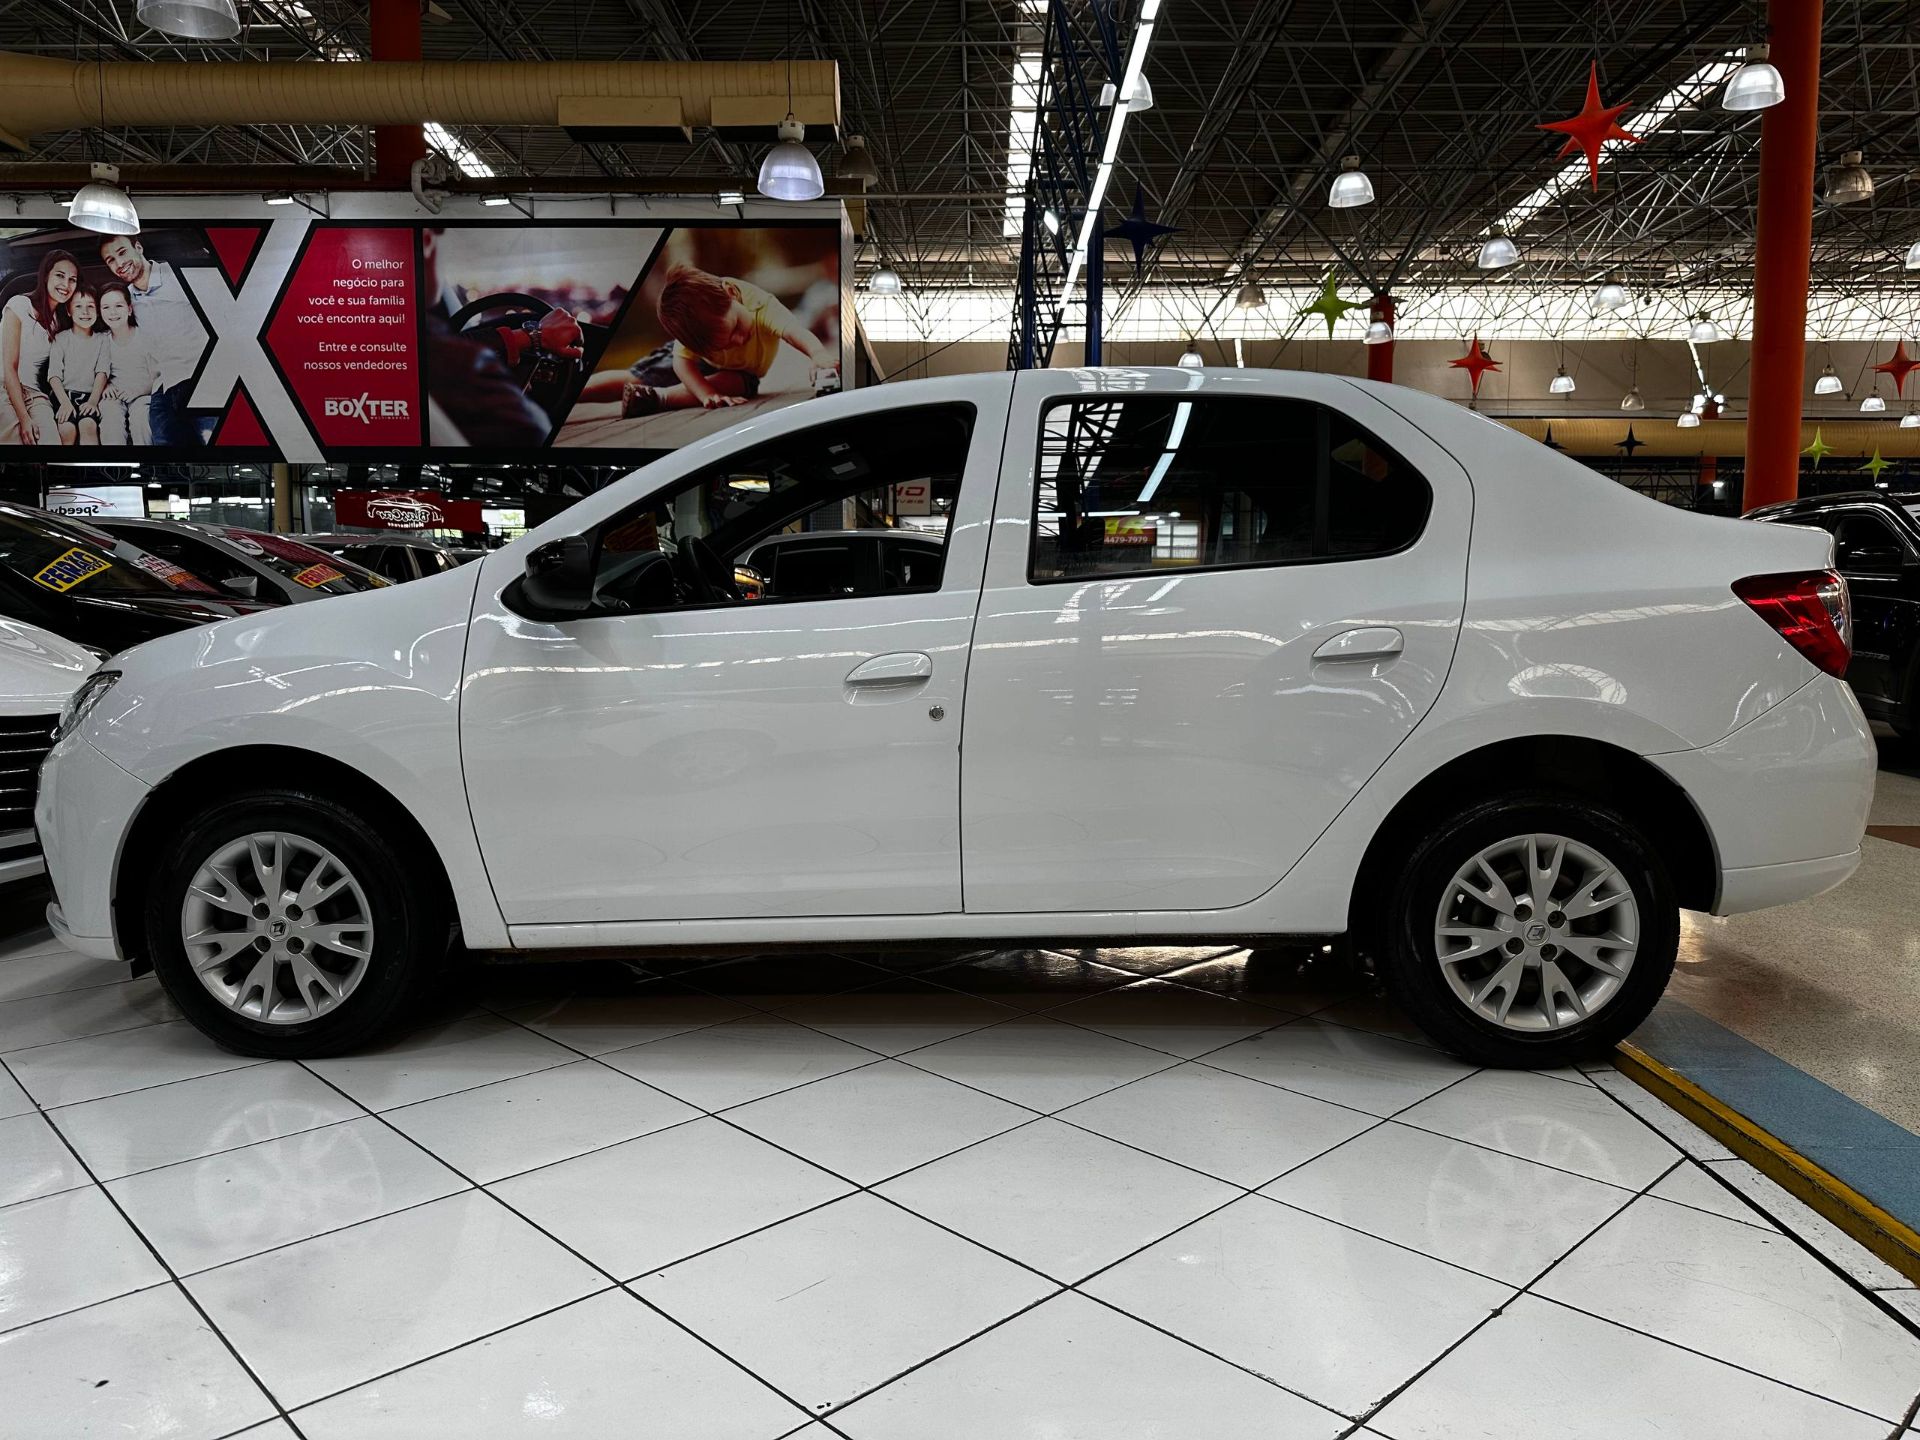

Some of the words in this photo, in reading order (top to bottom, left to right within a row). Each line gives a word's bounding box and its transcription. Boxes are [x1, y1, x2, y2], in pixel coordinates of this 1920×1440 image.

[351, 258, 362, 270] O
[363, 256, 405, 270] melhor
[333, 276, 378, 290] negócio
[380, 279, 405, 290] para
[308, 295, 336, 306] você
[337, 297, 345, 306] e
[347, 297, 366, 306] sua
[368, 295, 405, 306] família
[297, 313, 324, 324] você
[326, 313, 376, 324] encontra
[378, 313, 405, 326] aqui!
[319, 341, 348, 352] Entre
[350, 343, 357, 352] e
[359, 342, 407, 352] consulte
[304, 362, 342, 370] nossos
[343, 360, 408, 370] vendedores
[324, 392, 409, 424] BOXTER
